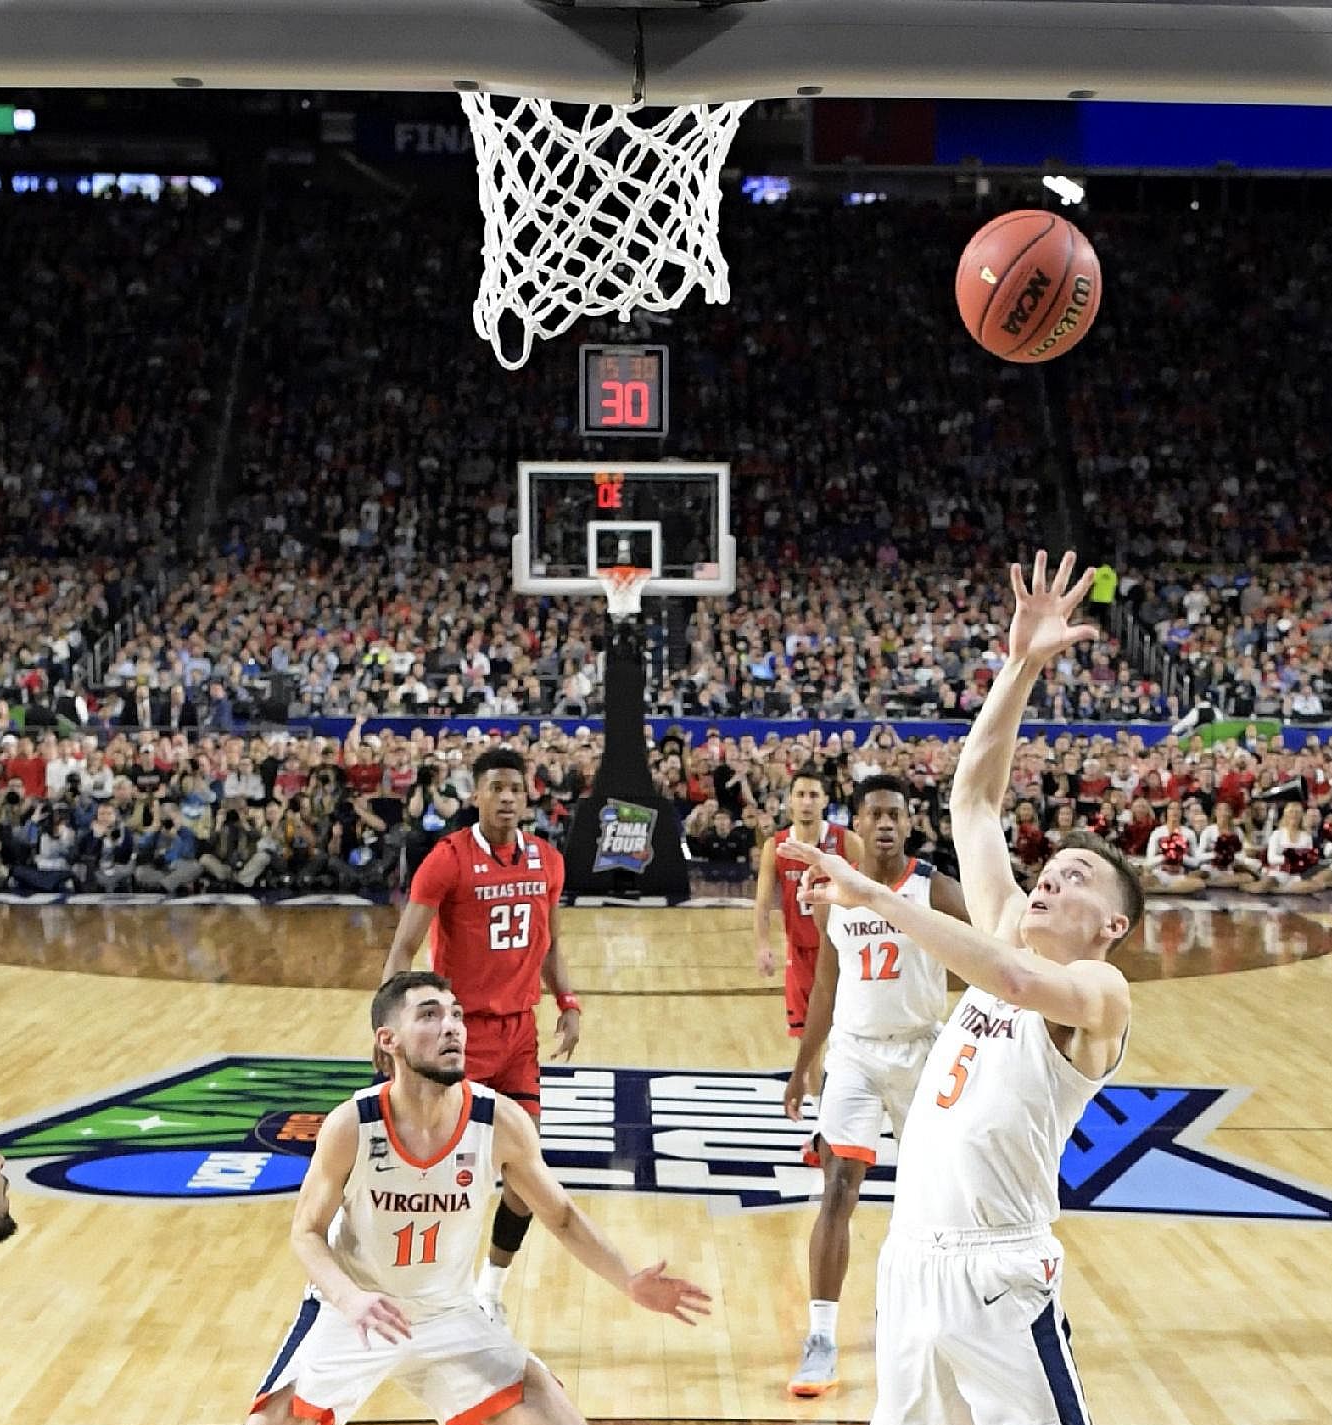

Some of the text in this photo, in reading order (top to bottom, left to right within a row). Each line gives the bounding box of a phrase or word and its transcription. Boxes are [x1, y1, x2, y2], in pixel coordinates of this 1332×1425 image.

[393, 122, 474, 153] FINA
[1002, 267, 1051, 335] NCAA
[1027, 273, 1091, 357] Wilson
[601, 380, 650, 426] 30
[601, 836, 647, 853] FOUR
[605, 820, 647, 838] FINAL
[474, 881, 547, 900] TEXAS TECH
[488, 903, 533, 950] 23
[842, 920, 903, 937] VIRGIN
[857, 941, 902, 981] 12
[936, 1043, 977, 1109] 5
[187, 1151, 273, 1191] NCAA
[370, 1189, 471, 1213] VIRGINIA
[392, 1220, 441, 1267] 11
